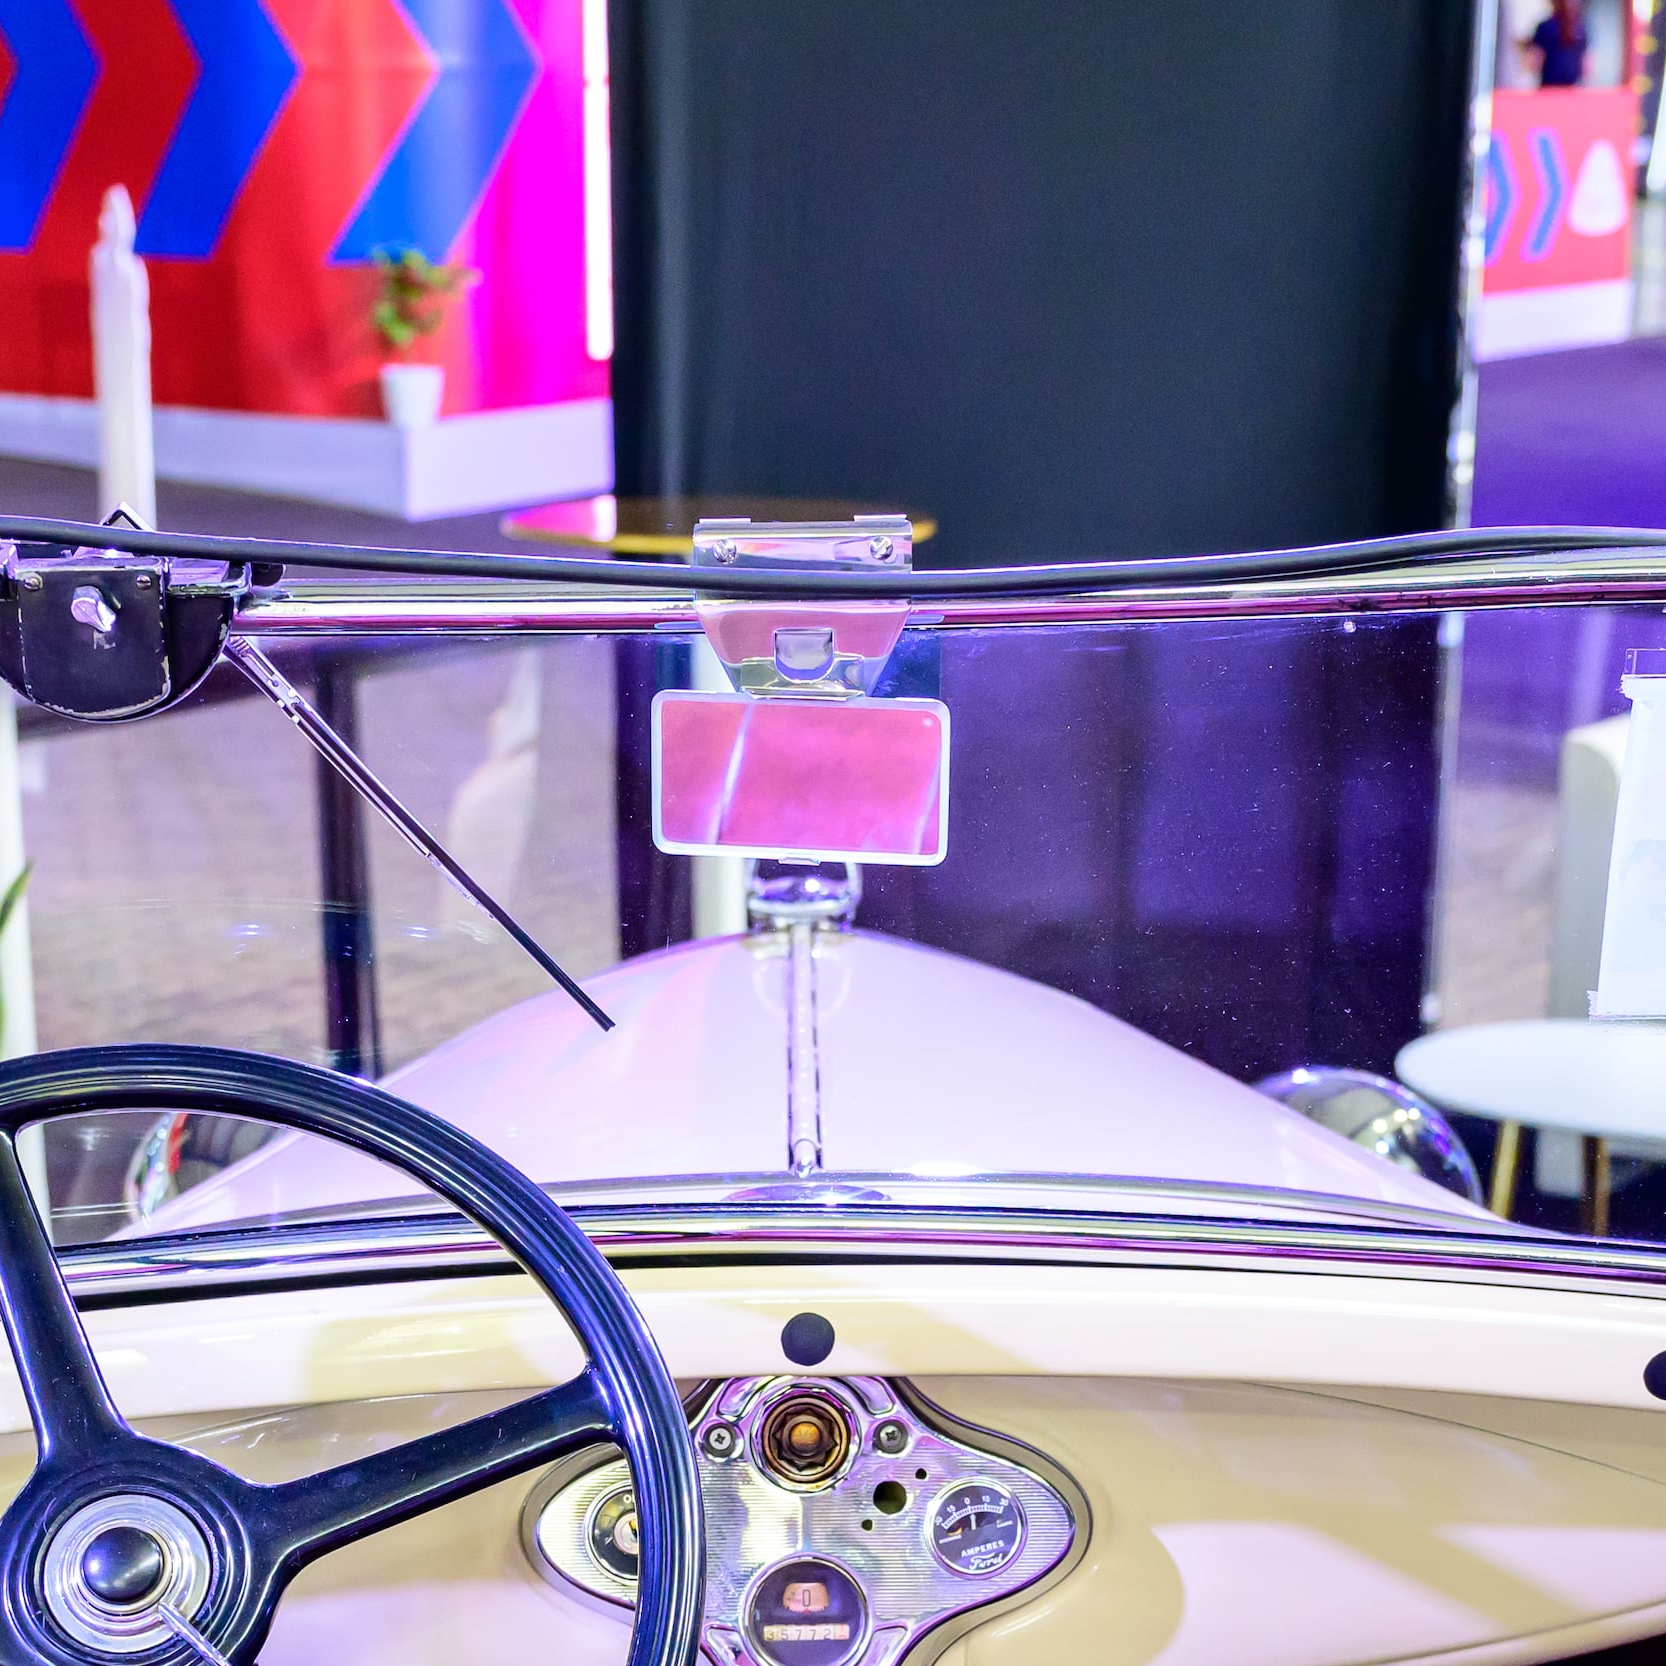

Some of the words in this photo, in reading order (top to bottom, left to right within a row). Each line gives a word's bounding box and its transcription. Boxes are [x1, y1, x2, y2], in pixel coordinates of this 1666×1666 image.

[946, 1505, 956, 1513] 15
[964, 1497, 971, 1505] 0
[982, 1495, 991, 1503] 15
[999, 1498, 1009, 1506] 30
[961, 1540, 1005, 1557] AMPERES
[969, 1552, 1003, 1570] Ford
[802, 1589, 812, 1607] 0
